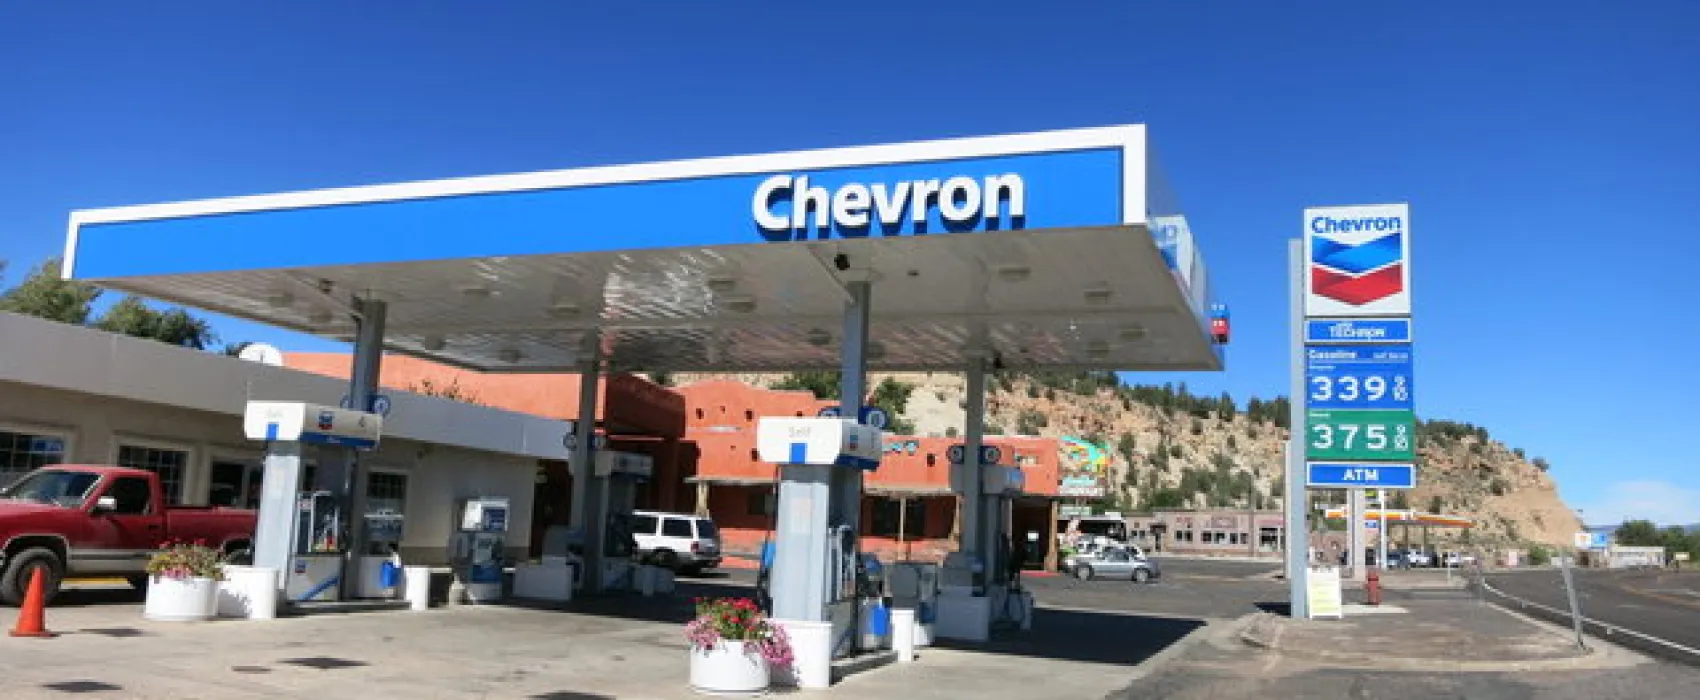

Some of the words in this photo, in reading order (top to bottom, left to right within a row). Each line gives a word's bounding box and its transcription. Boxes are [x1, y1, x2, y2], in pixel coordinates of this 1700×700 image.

[752, 173, 1025, 234] Chevron
[1311, 215, 1402, 233] Chevron
[1311, 375, 1386, 402] 339
[1311, 424, 1387, 451] 375
[1341, 468, 1379, 481] ATM
